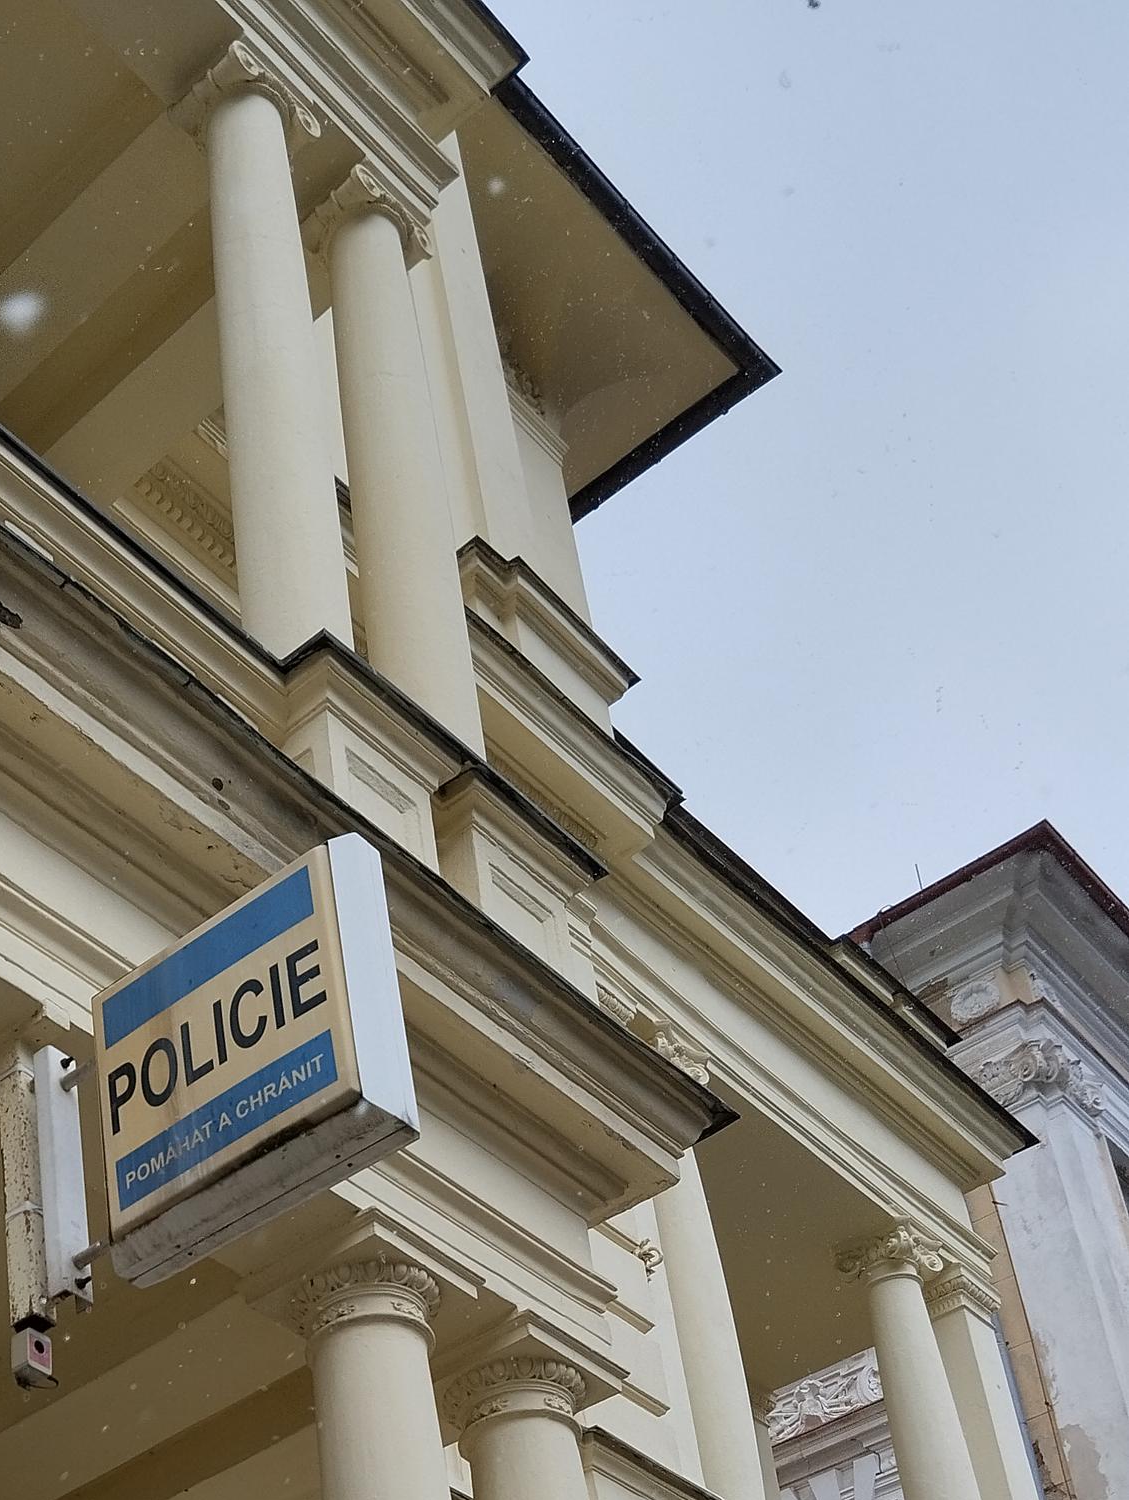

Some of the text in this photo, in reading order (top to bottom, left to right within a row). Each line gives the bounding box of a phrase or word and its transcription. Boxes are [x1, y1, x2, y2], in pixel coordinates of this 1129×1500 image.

[108, 938, 327, 1136] POLICIE
[218, 1112, 232, 1132] A
[235, 1053, 324, 1119] CHRÁNIT
